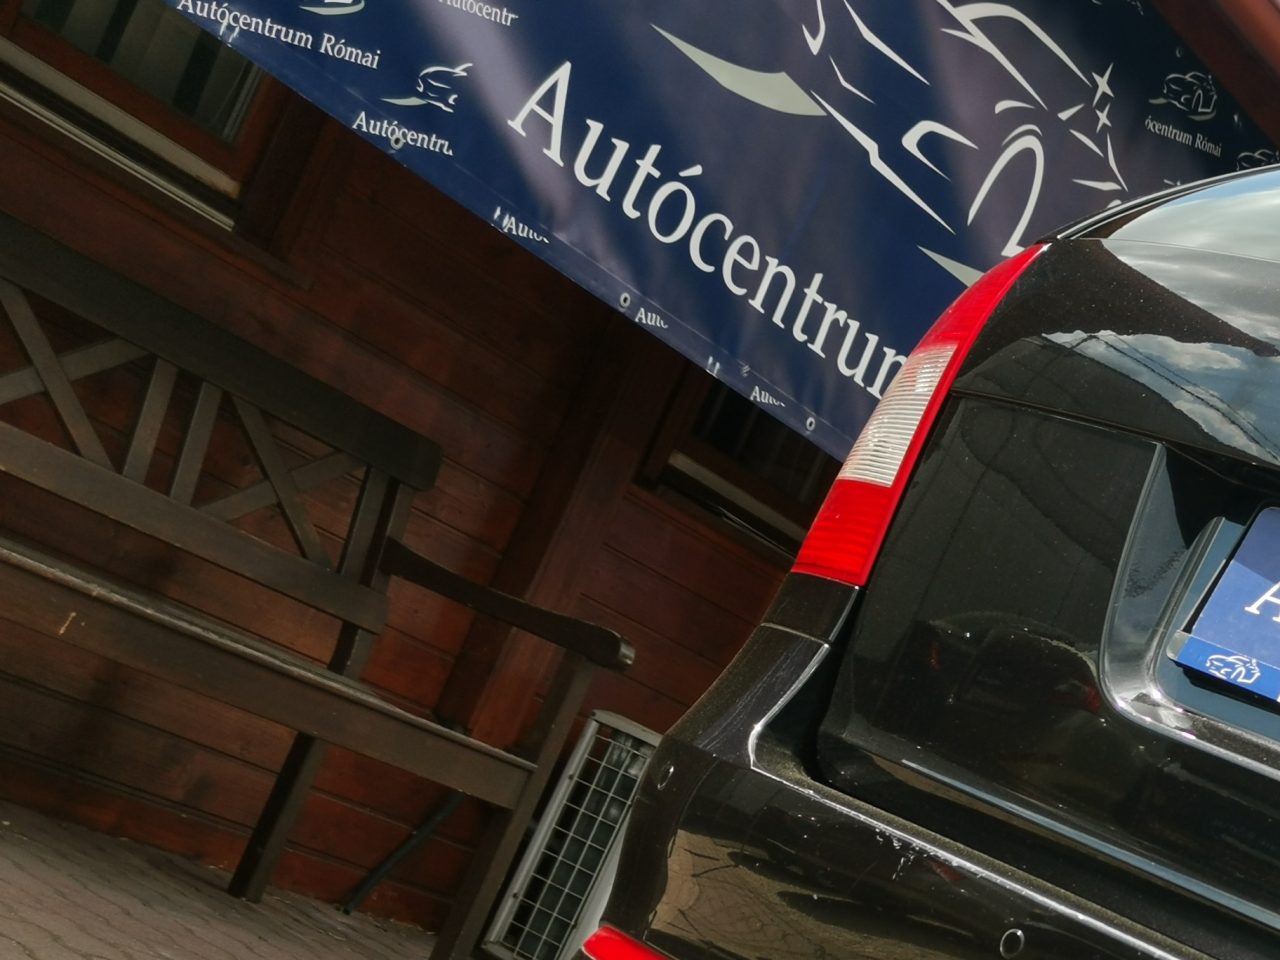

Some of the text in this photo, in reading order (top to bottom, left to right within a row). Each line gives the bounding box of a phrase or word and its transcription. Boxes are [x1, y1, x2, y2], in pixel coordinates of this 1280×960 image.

[176, 0, 381, 69] Autócentrum Római
[1194, 132, 1222, 157] Római
